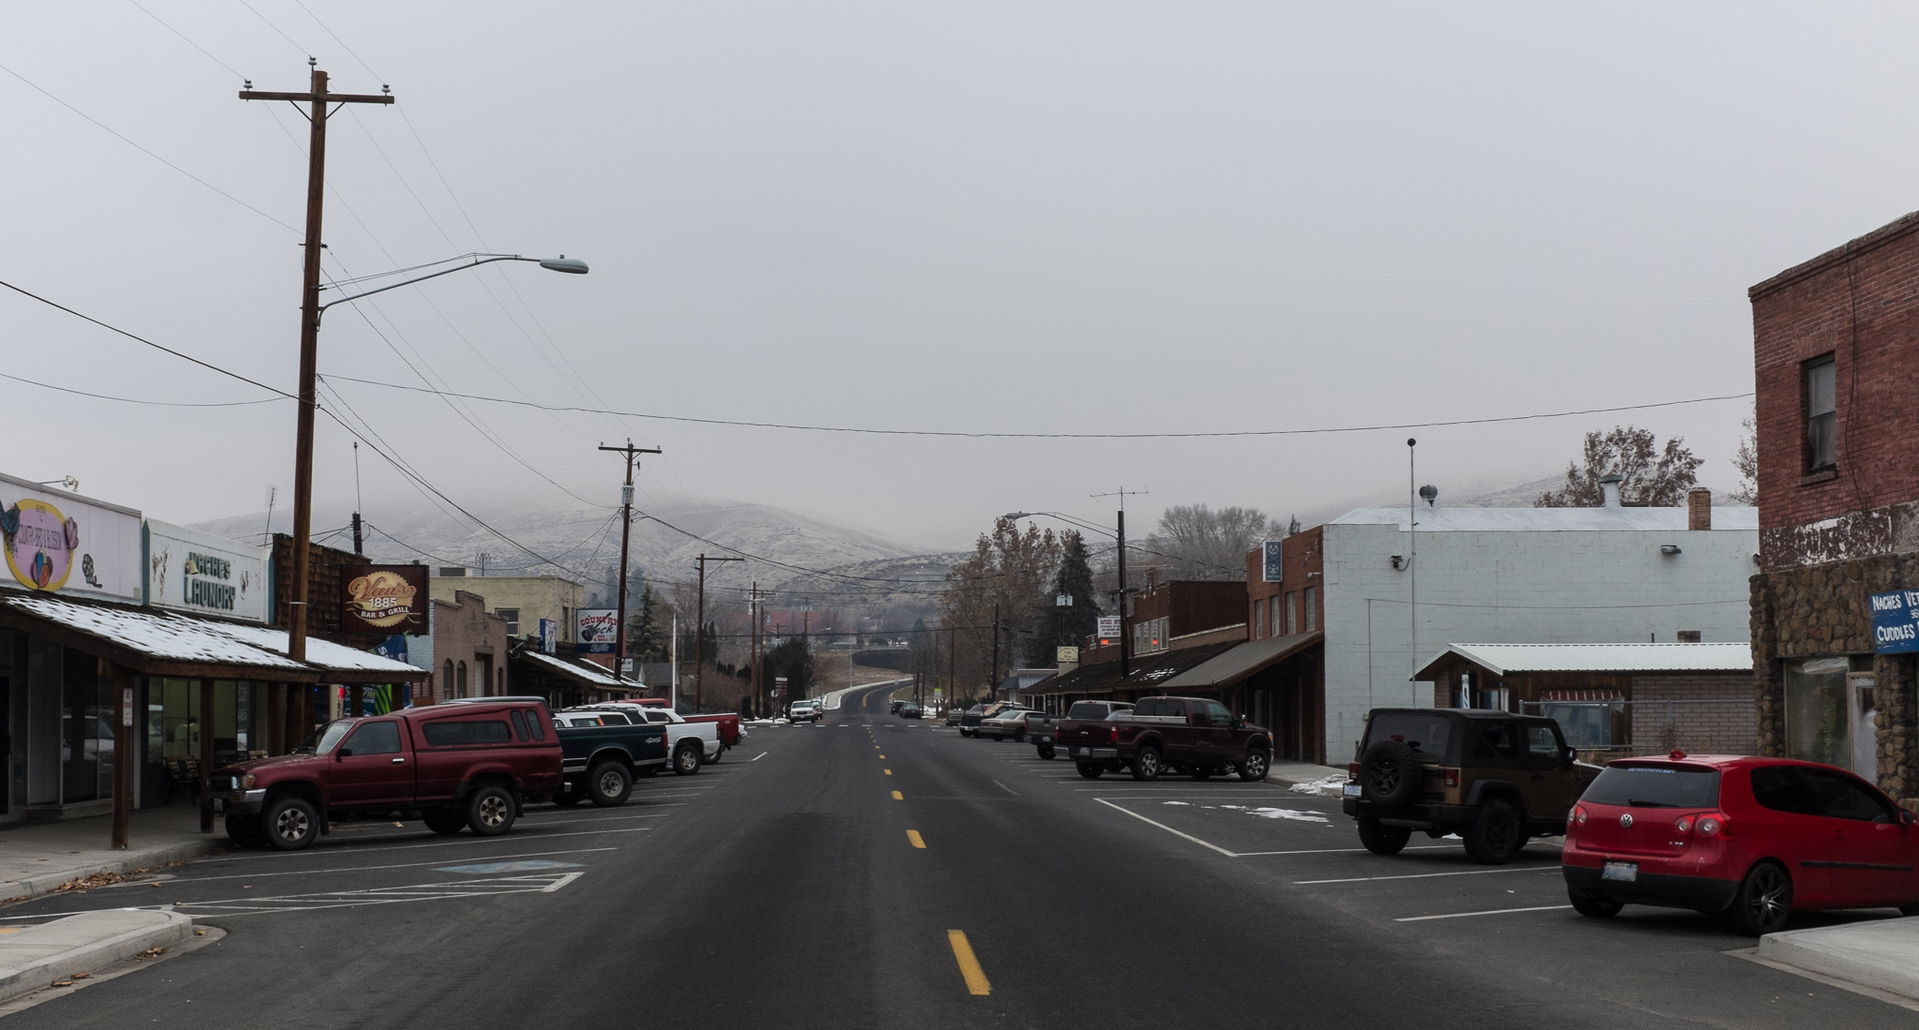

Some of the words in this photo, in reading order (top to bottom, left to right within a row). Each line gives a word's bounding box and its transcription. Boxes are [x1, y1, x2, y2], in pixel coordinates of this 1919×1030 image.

[184, 577, 236, 611] LAUNDRY
[1872, 594, 1902, 611] NACHES
[369, 597, 398, 609] 1885
[388, 607, 409, 615] GRILL
[1877, 623, 1915, 642] CUDDLES
